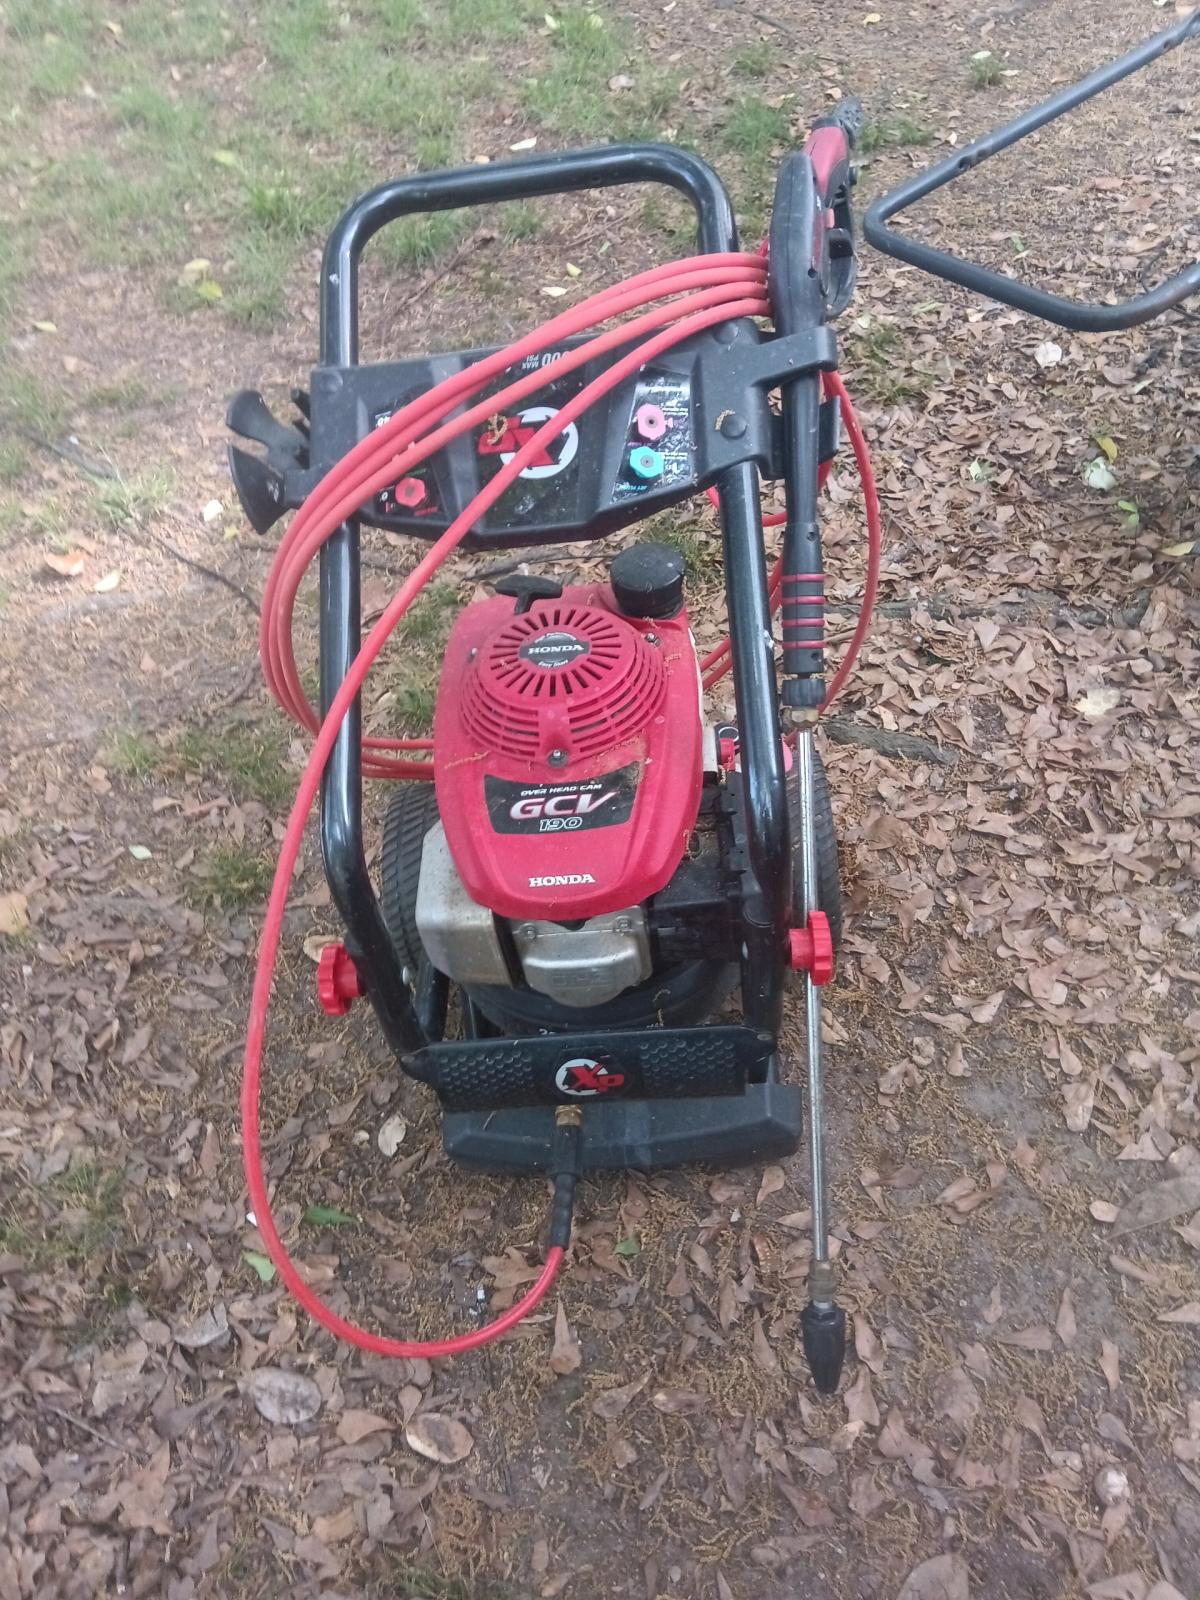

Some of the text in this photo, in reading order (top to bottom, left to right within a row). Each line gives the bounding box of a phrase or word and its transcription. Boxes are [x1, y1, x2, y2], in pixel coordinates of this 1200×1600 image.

[528, 644, 584, 655] HONDA
[520, 783, 603, 797] OVER HEAD CAM
[510, 790, 620, 820] GCV
[539, 816, 584, 832] 190
[528, 873, 596, 888] HONDA
